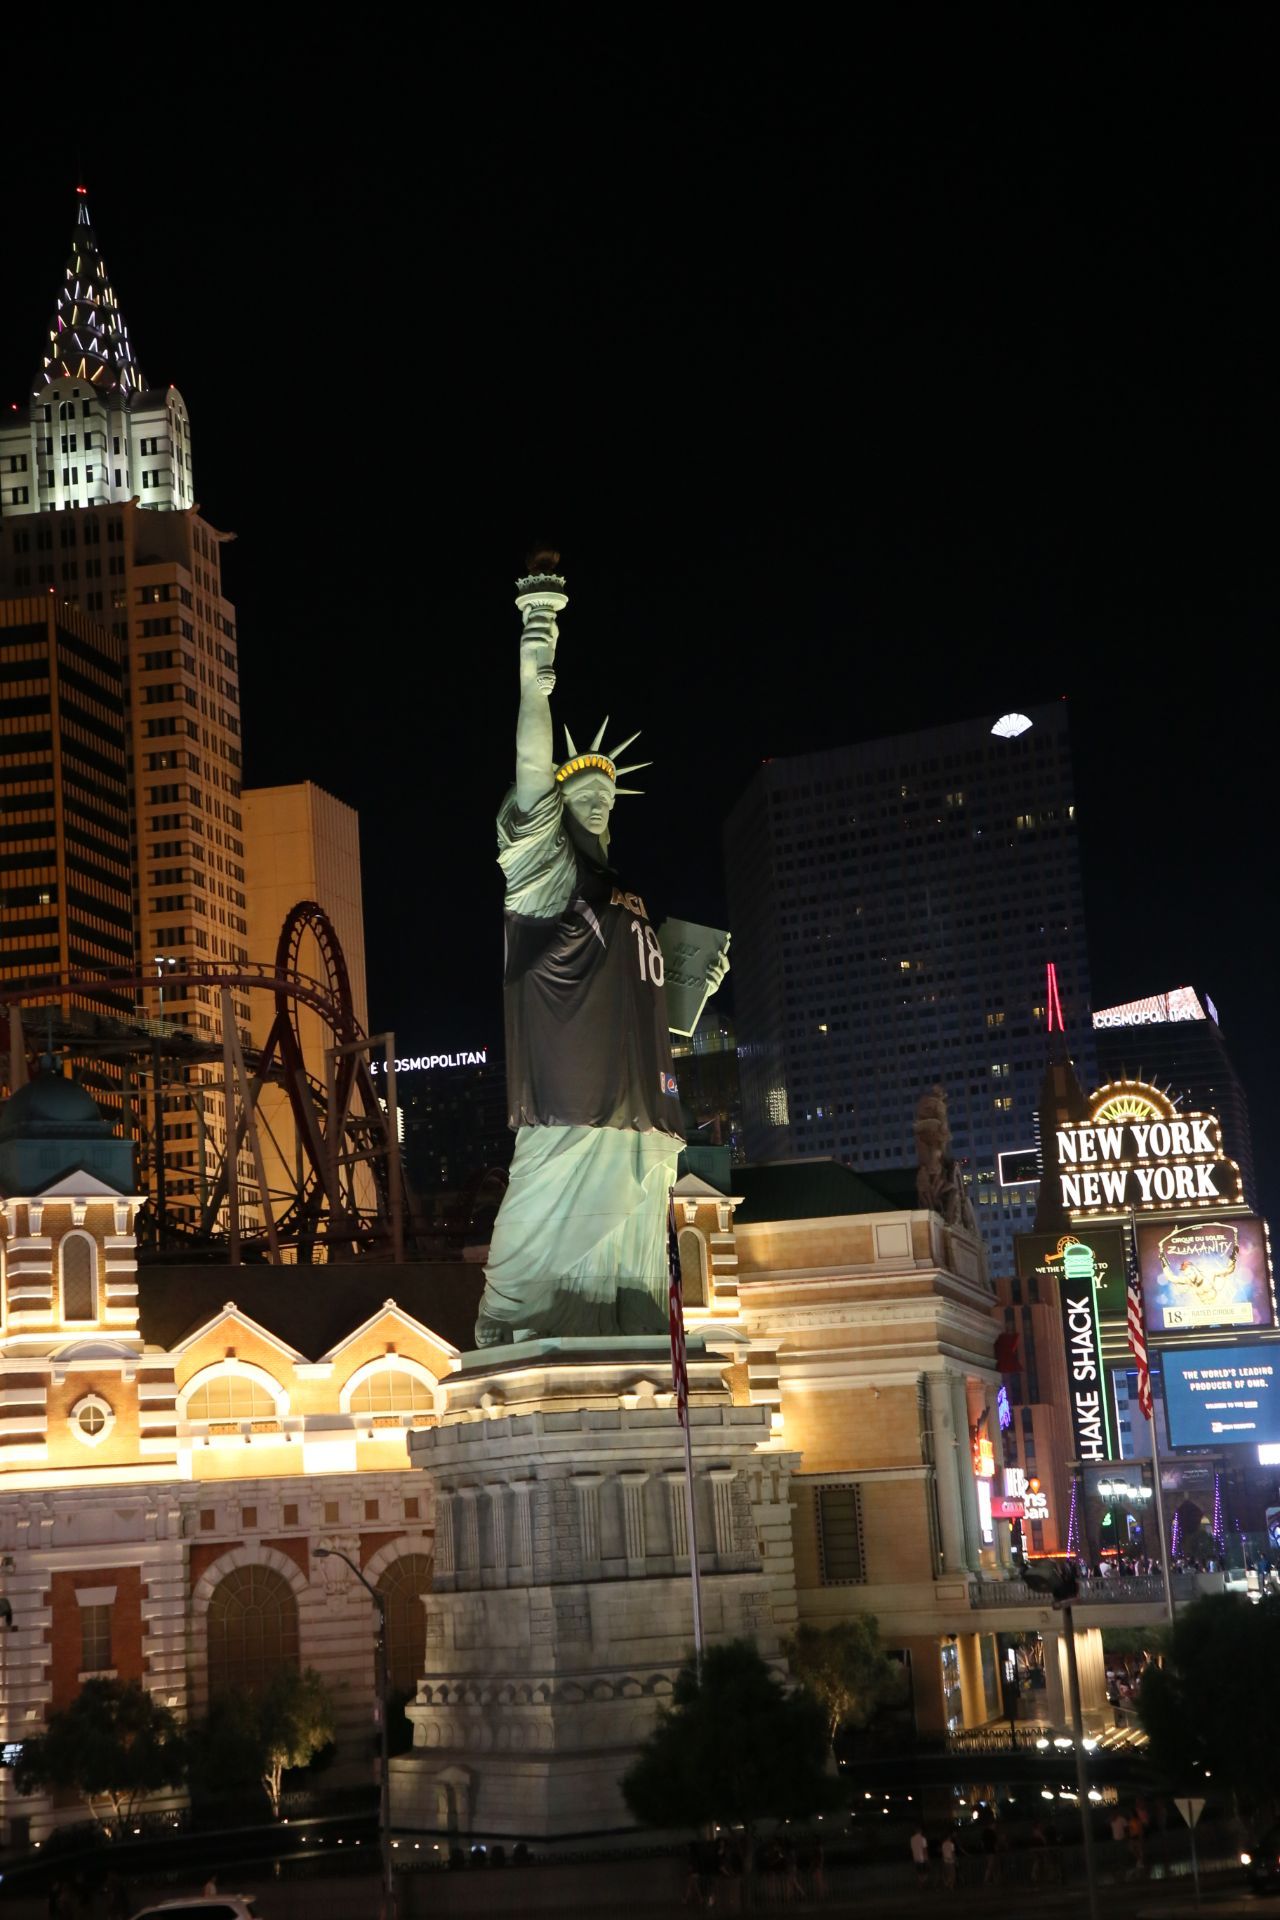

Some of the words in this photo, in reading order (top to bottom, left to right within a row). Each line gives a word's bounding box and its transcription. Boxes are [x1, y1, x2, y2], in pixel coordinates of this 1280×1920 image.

[631, 920, 664, 987] 18
[1095, 1007, 1197, 1028] COSMOPOLITAN
[1056, 1127, 1123, 1164] NEW
[1129, 1119, 1215, 1157] YORK
[1060, 1170, 1127, 1207] NEW
[1134, 1163, 1219, 1202] YORK
[1167, 1240, 1232, 1256] ZUMANITY
[1066, 1296, 1096, 1380] SHACK
[1182, 1371, 1199, 1380] THE
[1201, 1368, 1236, 1379] WORLD'S
[1239, 1366, 1273, 1377] LEADING
[1190, 1381, 1232, 1391] PRODUCER
[1235, 1380, 1245, 1389] OF
[1076, 1390, 1104, 1461] HAKE
